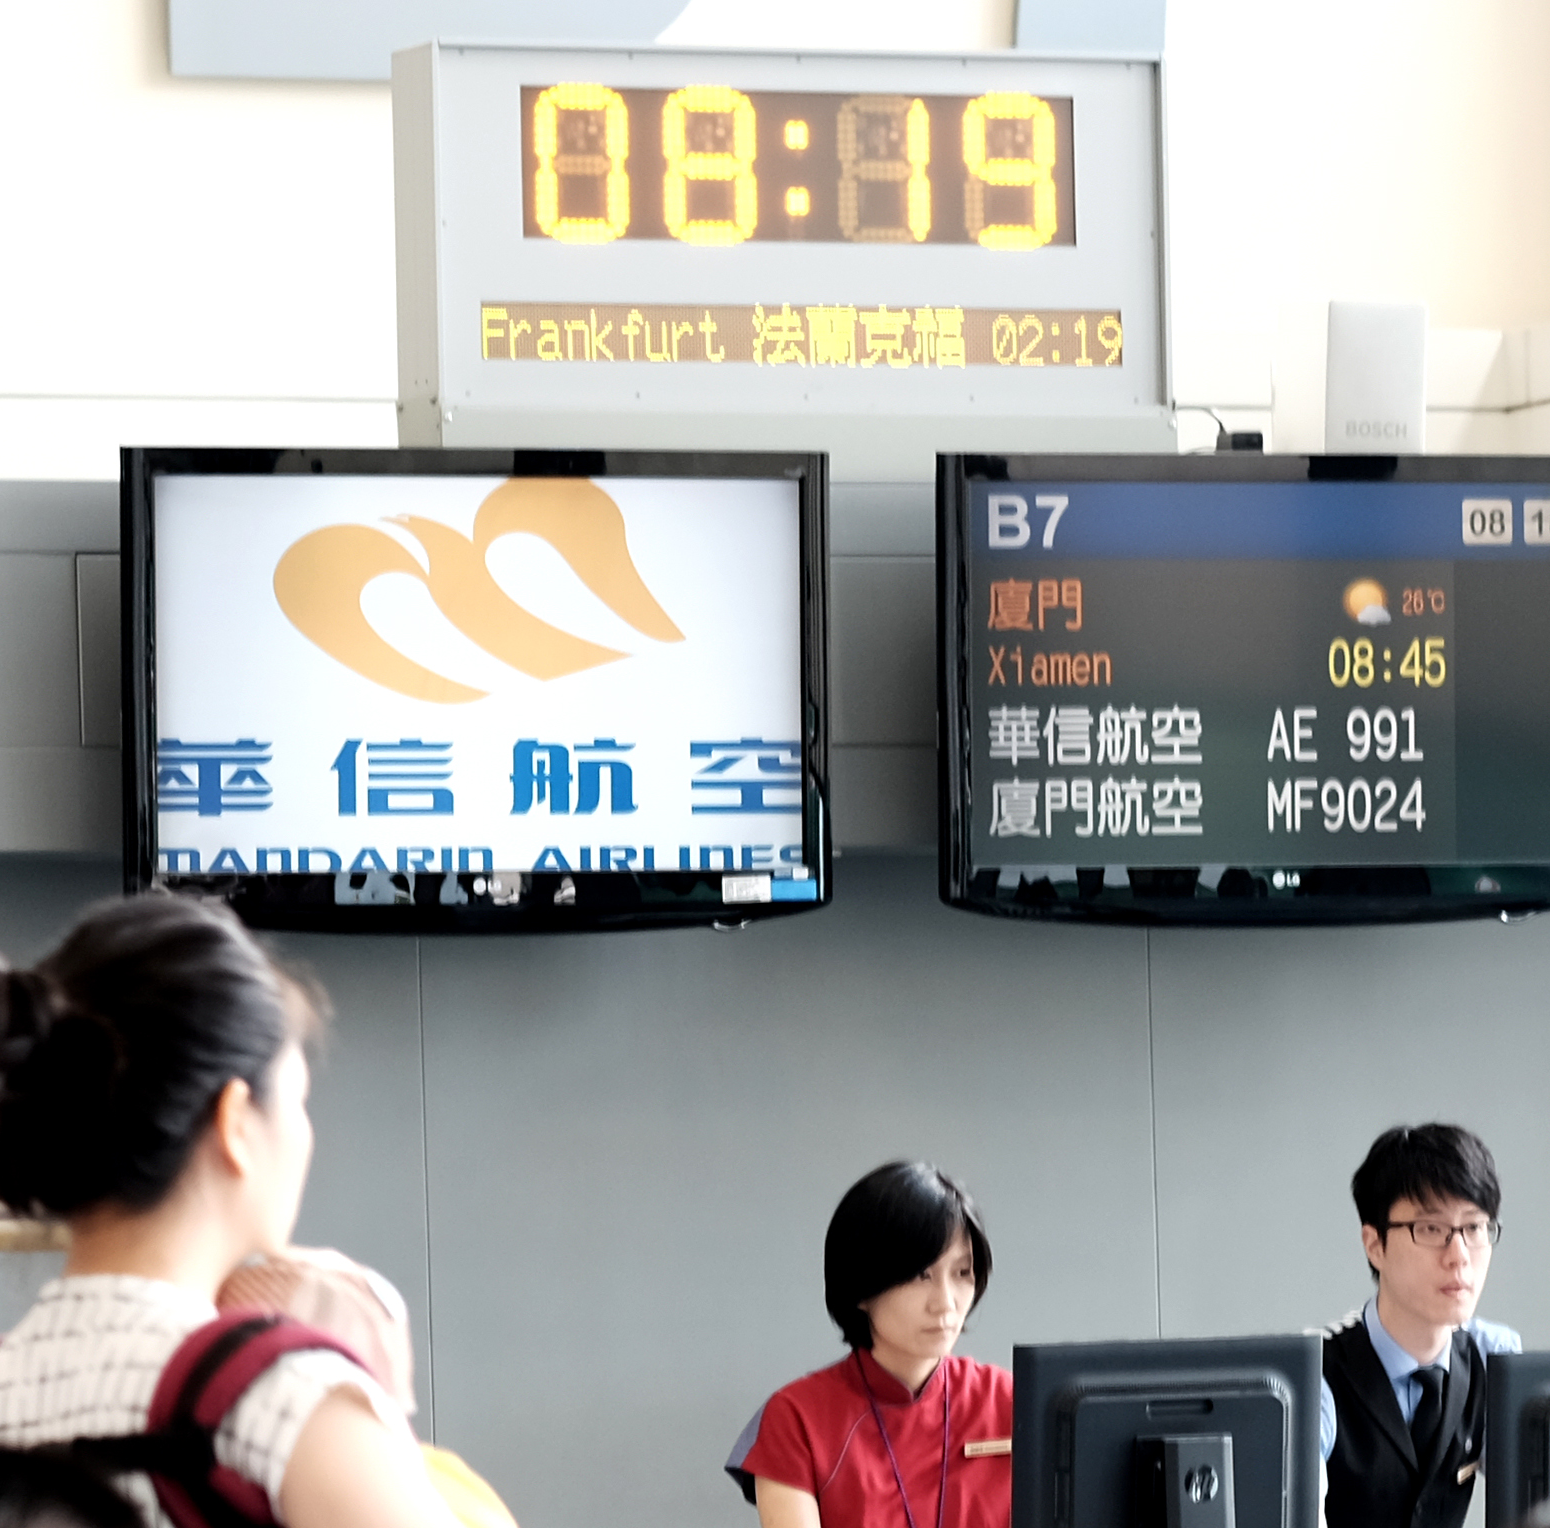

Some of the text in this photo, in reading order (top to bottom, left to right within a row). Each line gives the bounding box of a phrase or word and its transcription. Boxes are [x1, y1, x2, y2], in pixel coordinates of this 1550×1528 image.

[534, 81, 1056, 250] 08:19
[481, 304, 1123, 369] Frankfurt 法蘭克福 02:19
[1345, 420, 1407, 438] BOSCH
[987, 495, 1070, 550] B7
[1469, 508, 1506, 538] 08
[987, 577, 1083, 631] 廈門
[988, 647, 1112, 687] Xiamen
[1327, 637, 1446, 688] 08:45
[988, 704, 1203, 766] 華信航空
[1267, 707, 1424, 762] AE 991
[988, 776, 1203, 838] 廈門航空
[1266, 777, 1427, 833] MF9024
